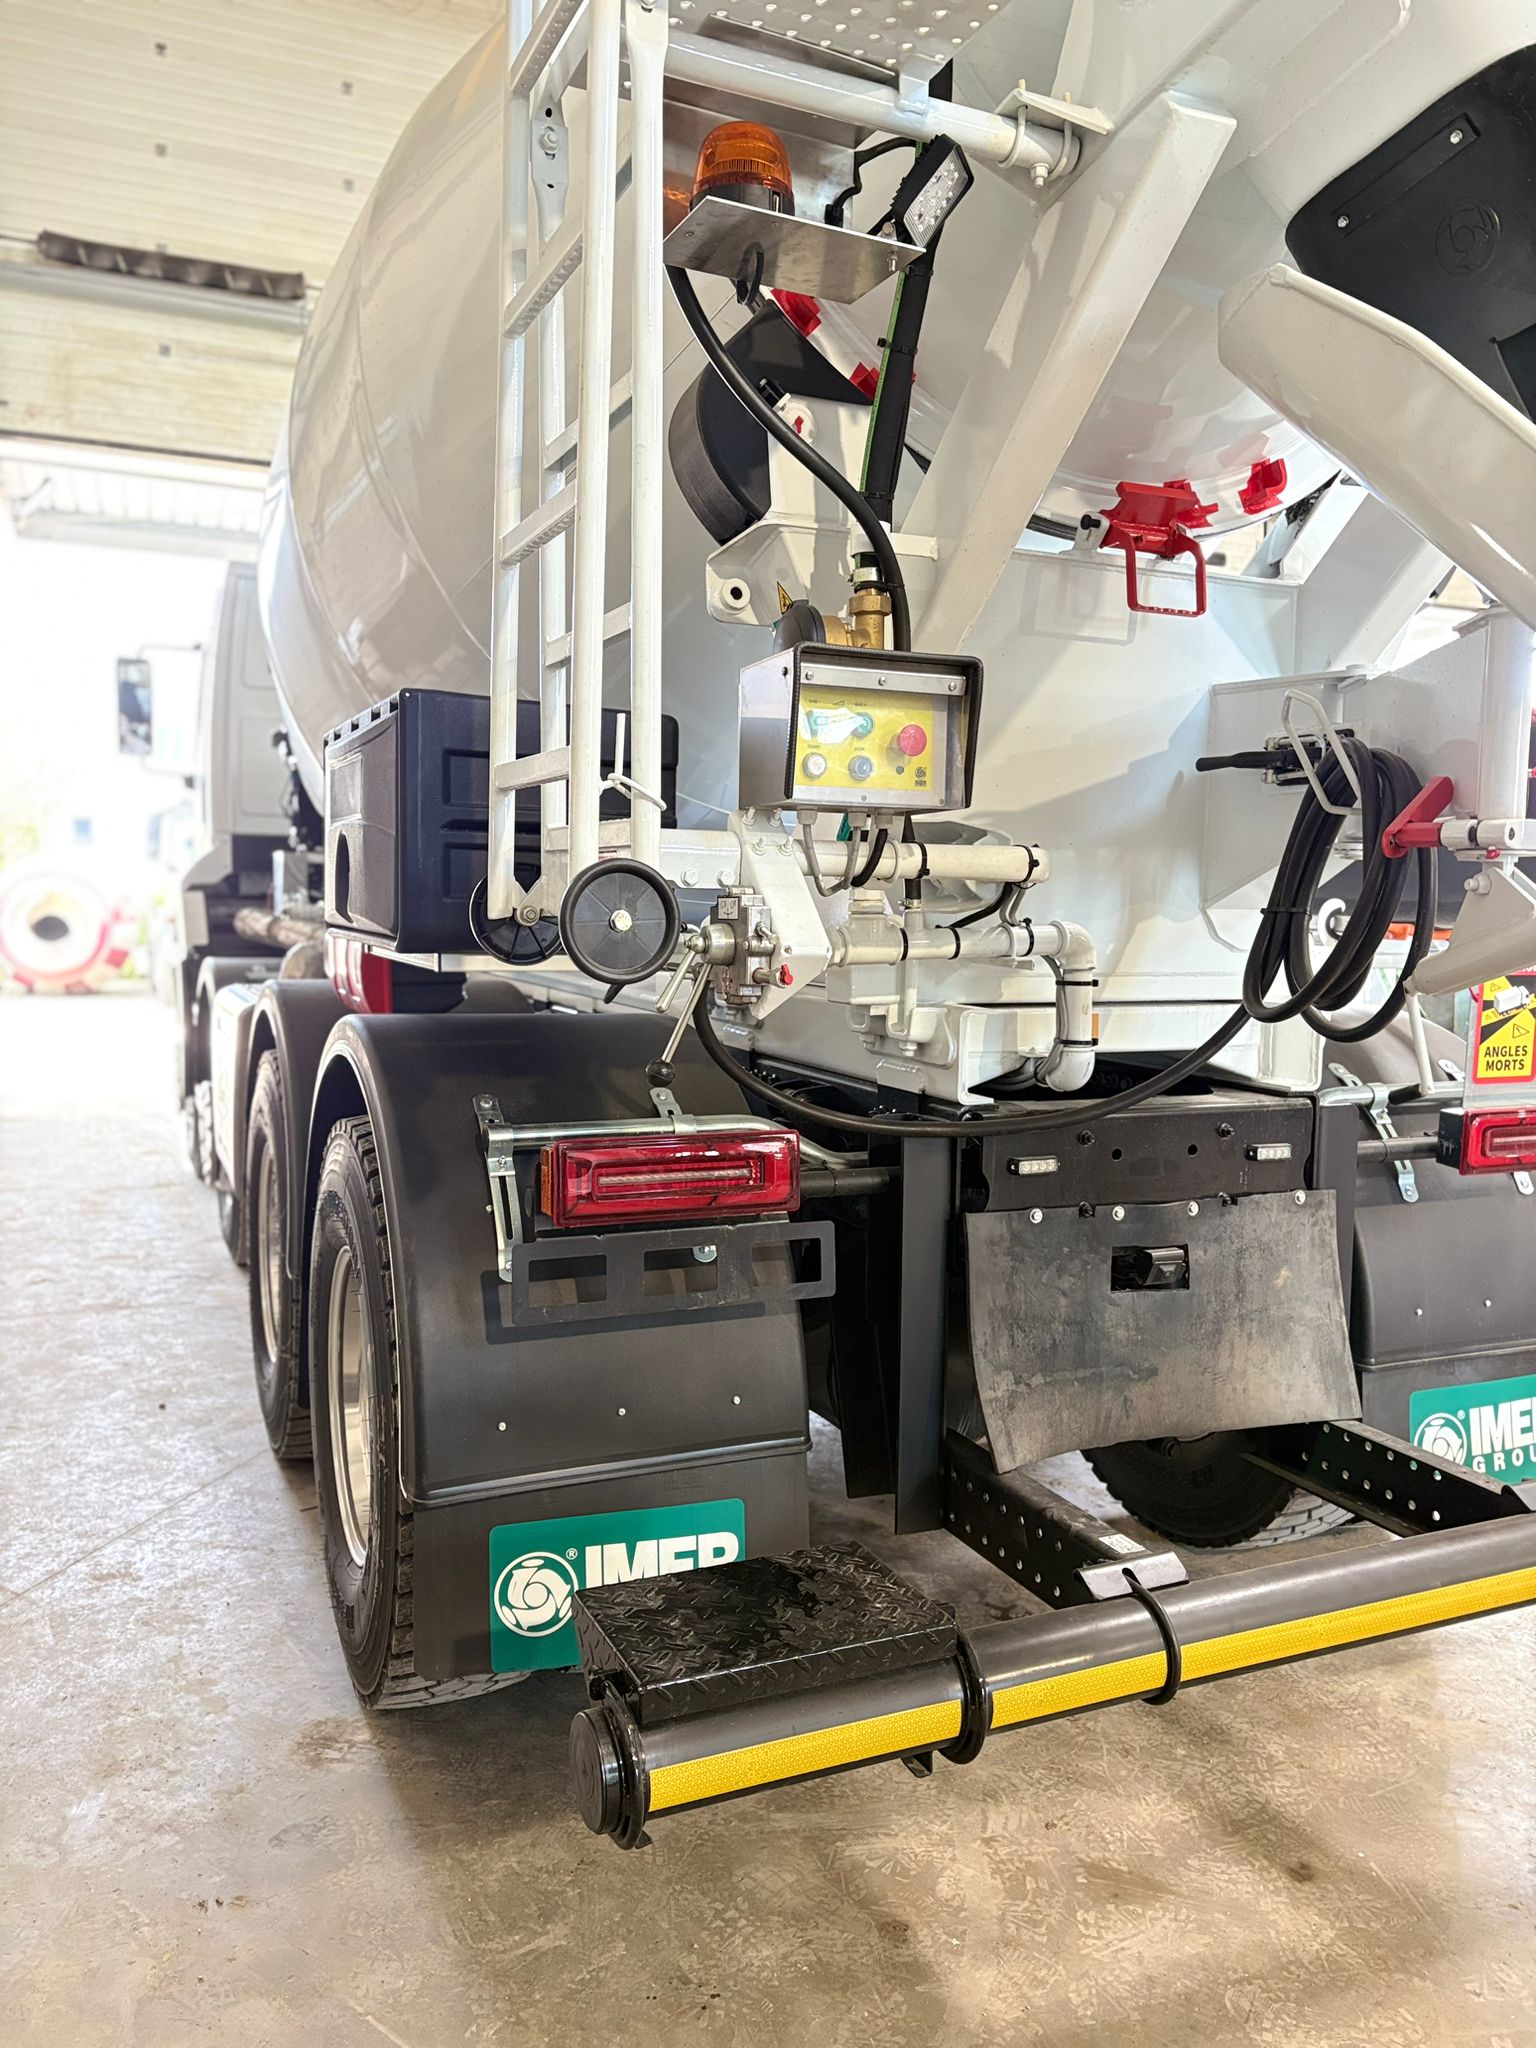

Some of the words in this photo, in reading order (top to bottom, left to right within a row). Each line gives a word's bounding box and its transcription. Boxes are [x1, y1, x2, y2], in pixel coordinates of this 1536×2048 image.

[1484, 1045, 1528, 1058] ANGLES
[1485, 1059, 1525, 1072] MORTS
[1469, 1396, 1536, 1457] IME
